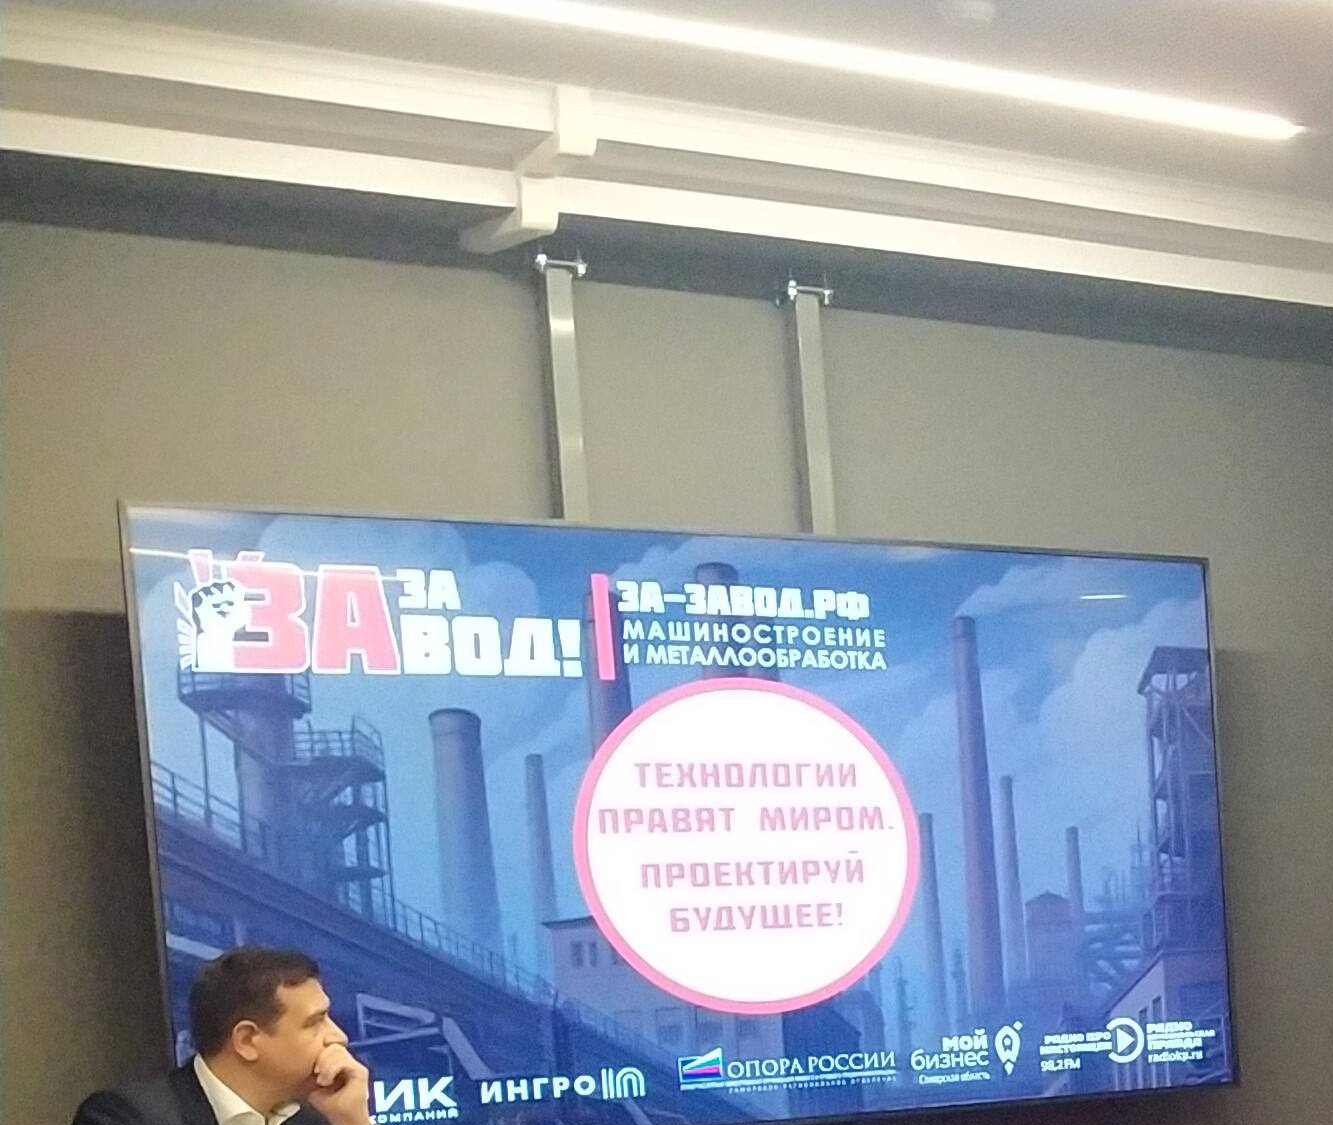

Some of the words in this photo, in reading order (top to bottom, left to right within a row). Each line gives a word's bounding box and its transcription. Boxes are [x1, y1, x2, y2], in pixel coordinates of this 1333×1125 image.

[398, 569, 462, 610] ЗА
[616, 581, 870, 620] ЗА-ЗАВОД.РФ
[399, 615, 584, 677] ВОД!
[622, 620, 886, 648] МАШИНОСТРОЕНИЕ
[623, 648, 639, 664] И
[646, 645, 888, 670] МЕТАЛЛООБРАБОТКА
[633, 763, 858, 788] ТЕХНОЛОГИИ
[598, 807, 735, 834] ПРАВЯТ
[760, 806, 895, 832] МИРОМ.
[641, 850, 865, 888] ПРОЕКТИРУЙ
[669, 902, 843, 933] БУДУЩЕЕ!
[942, 1028, 988, 1051] мой
[727, 1056, 804, 1078] ОПОРА
[808, 1050, 896, 1073] РОССИИ
[910, 1049, 990, 1071] бизнес
[373, 1076, 458, 1113] ИК
